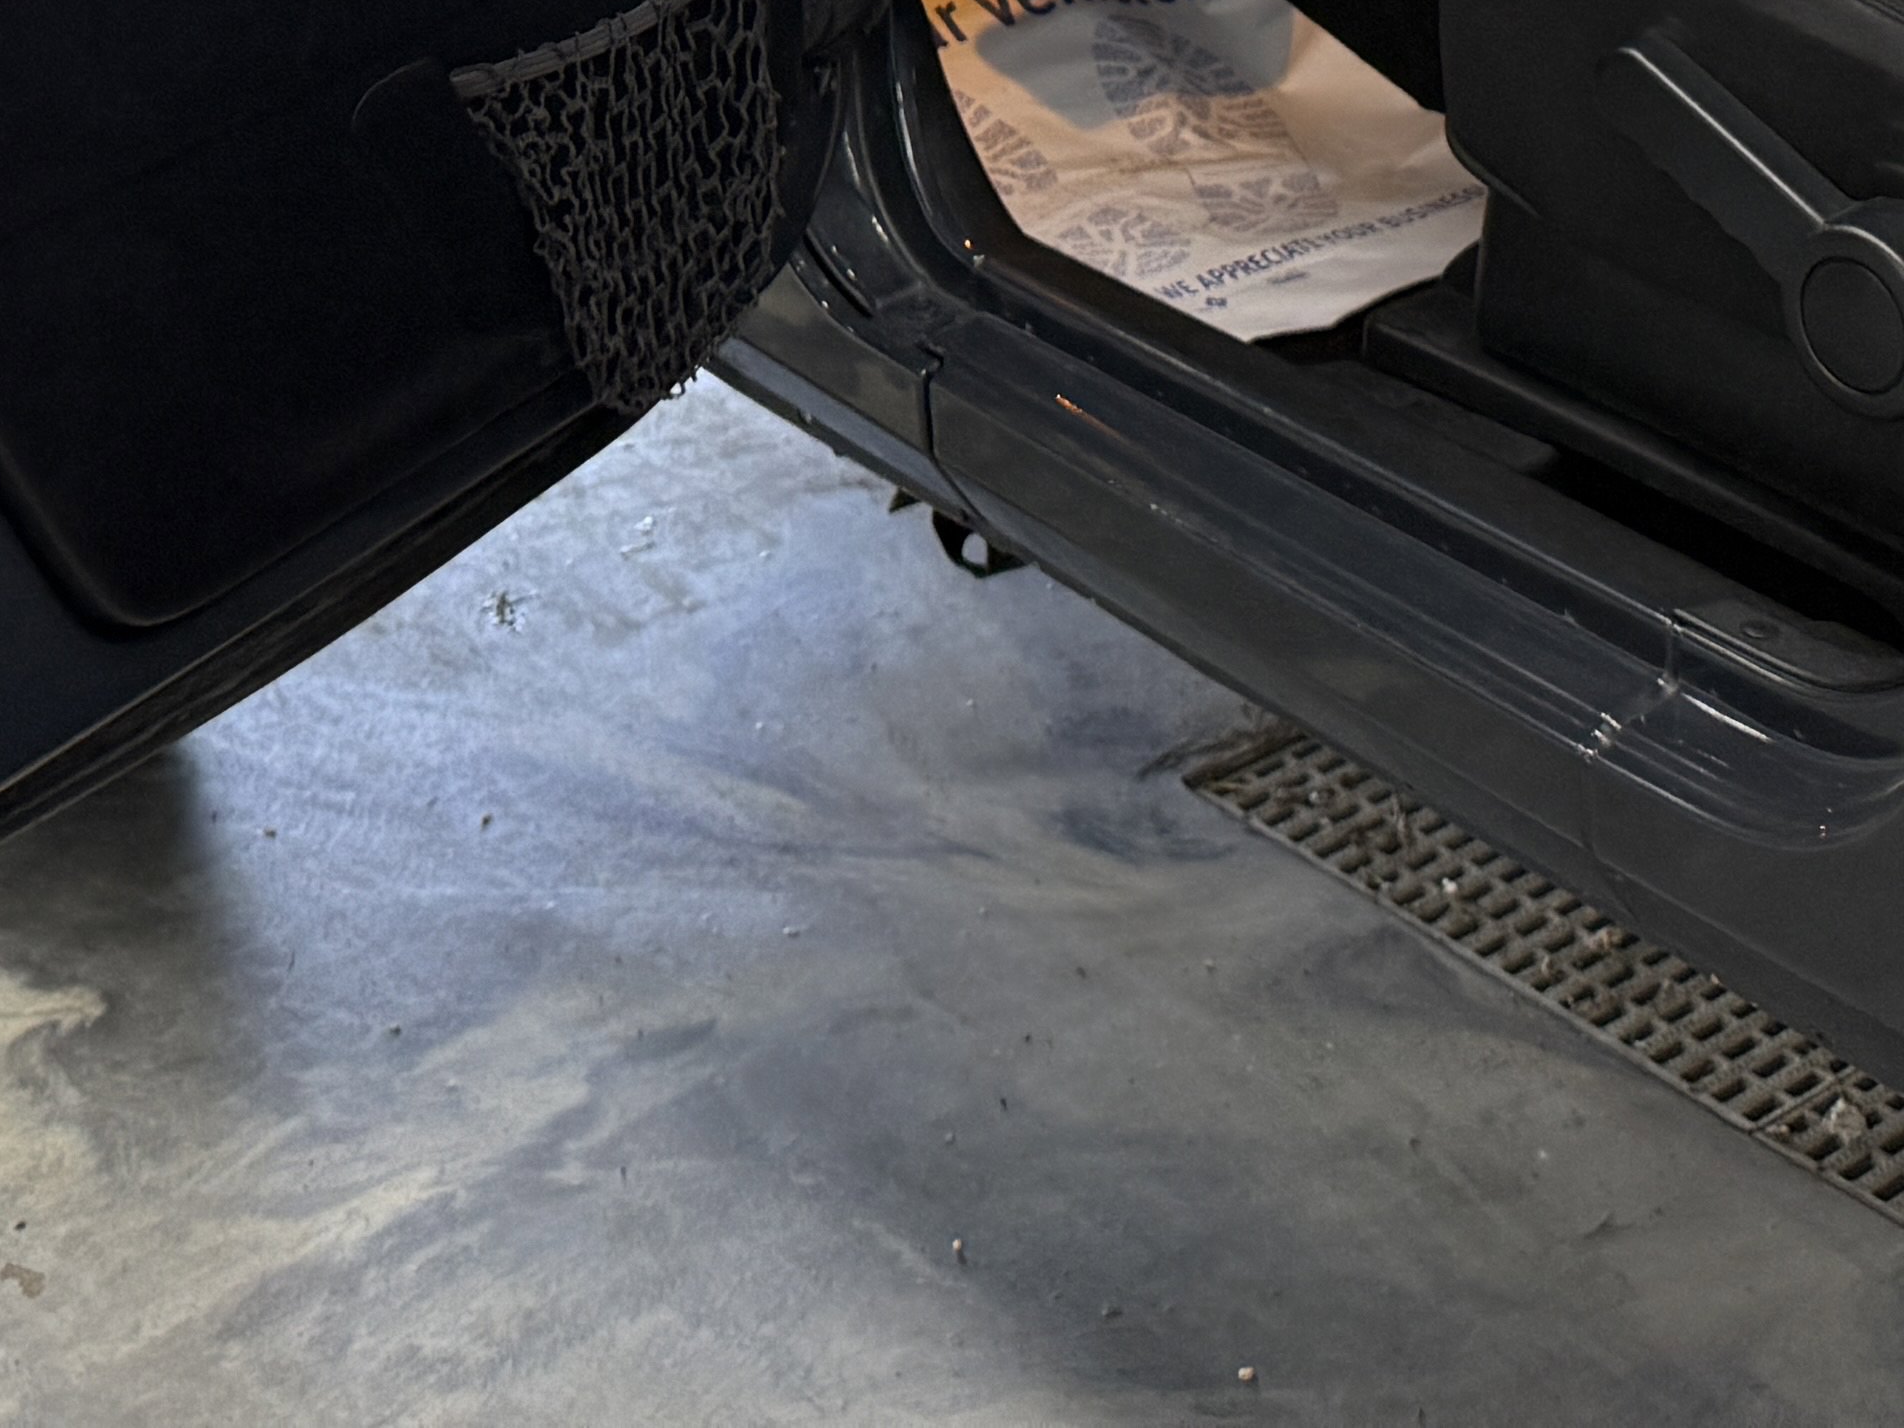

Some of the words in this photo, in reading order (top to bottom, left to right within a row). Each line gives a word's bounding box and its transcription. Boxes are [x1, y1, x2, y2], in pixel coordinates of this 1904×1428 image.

[1155, 278, 1197, 300] WE
[1197, 238, 1322, 290] APPRECIATE
[1322, 221, 1379, 249] YOUR
